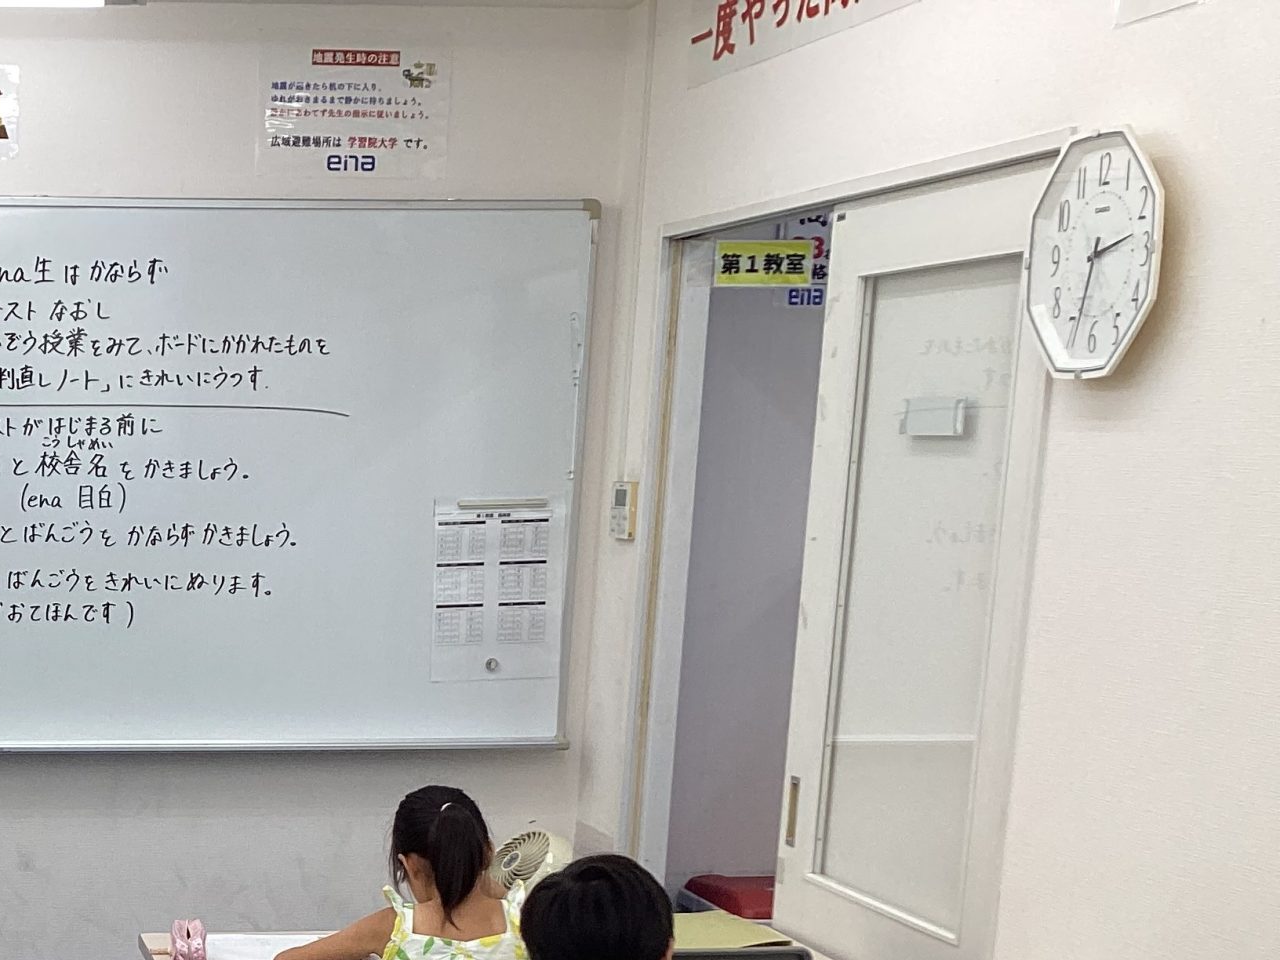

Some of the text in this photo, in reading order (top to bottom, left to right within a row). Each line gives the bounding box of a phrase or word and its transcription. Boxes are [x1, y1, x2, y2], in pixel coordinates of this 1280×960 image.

[312, 51, 400, 65] 地震発生時の注意
[347, 136, 398, 149] 学習院大学
[403, 138, 429, 150] です。
[326, 153, 376, 172] ena
[1099, 152, 1113, 187] 12
[1058, 199, 1070, 233] 10
[1138, 185, 1148, 220] 2
[721, 253, 806, 275] 第1教室
[1051, 245, 1061, 278] 9
[1139, 231, 1150, 267] 3
[788, 288, 824, 306] ena
[1053, 287, 1061, 319] 8
[1131, 279, 1141, 312] 4
[1088, 320, 1099, 353] 6
[1111, 312, 1122, 346] 5
